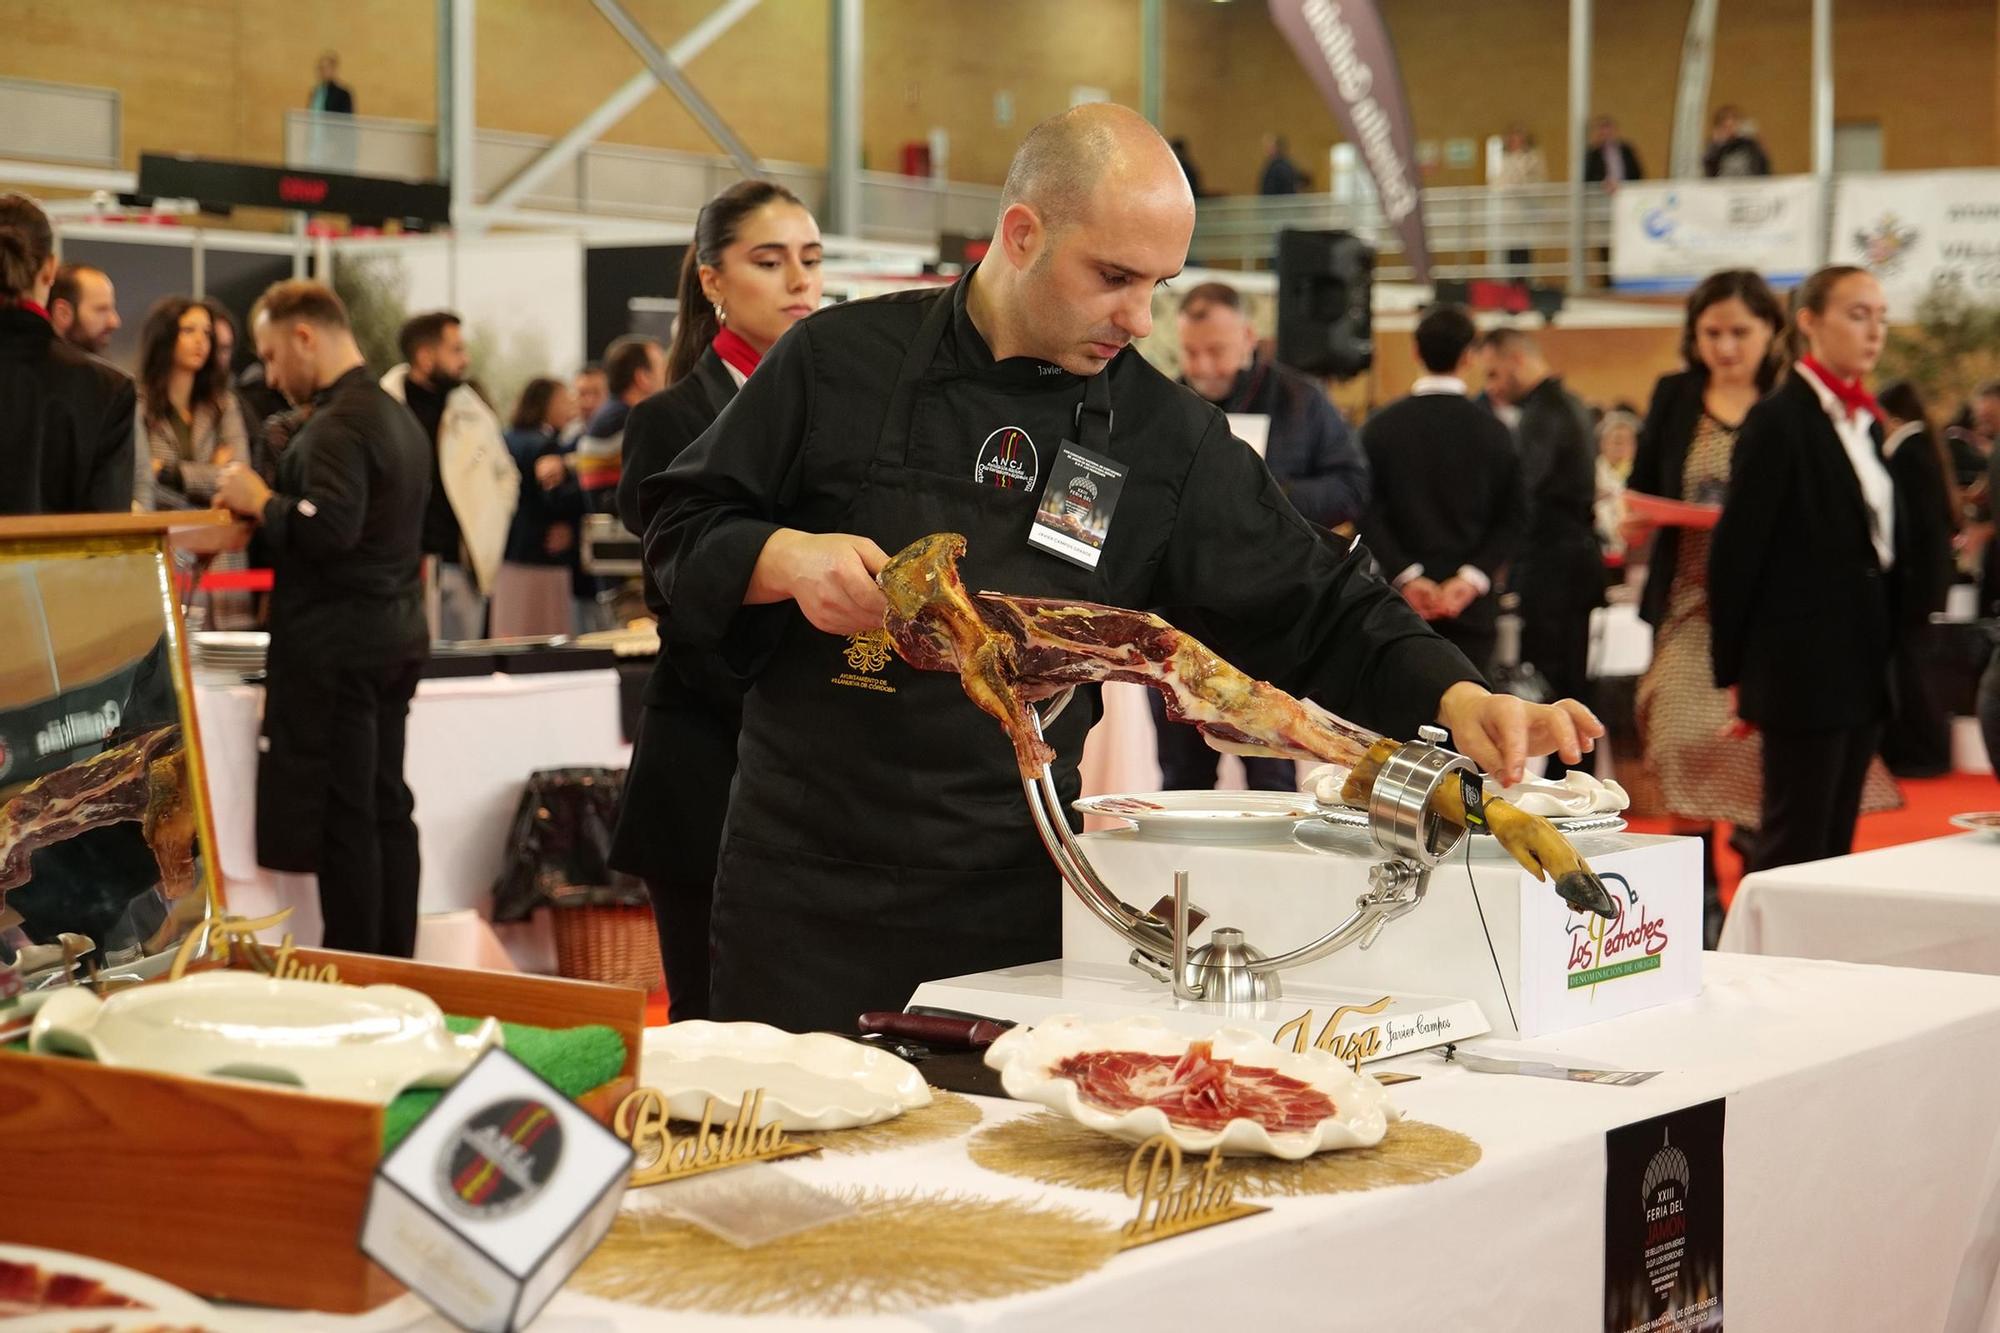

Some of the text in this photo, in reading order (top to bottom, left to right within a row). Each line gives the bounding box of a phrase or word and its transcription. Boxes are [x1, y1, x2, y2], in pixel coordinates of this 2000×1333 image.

[1037, 366, 1063, 376] Javier
[1567, 933, 1593, 970] Los
[1624, 963, 1633, 973] DE
[1386, 1021, 1415, 1051] Javier
[614, 1088, 788, 1174] Babilla
[1121, 1134, 1233, 1236] Punta
[1657, 1186, 1675, 1204] XXIII
[1646, 1199, 1684, 1223] FERIA DEL
[1676, 1308, 1684, 1319] DE
[1684, 1296, 1718, 1316] CORTADORES
